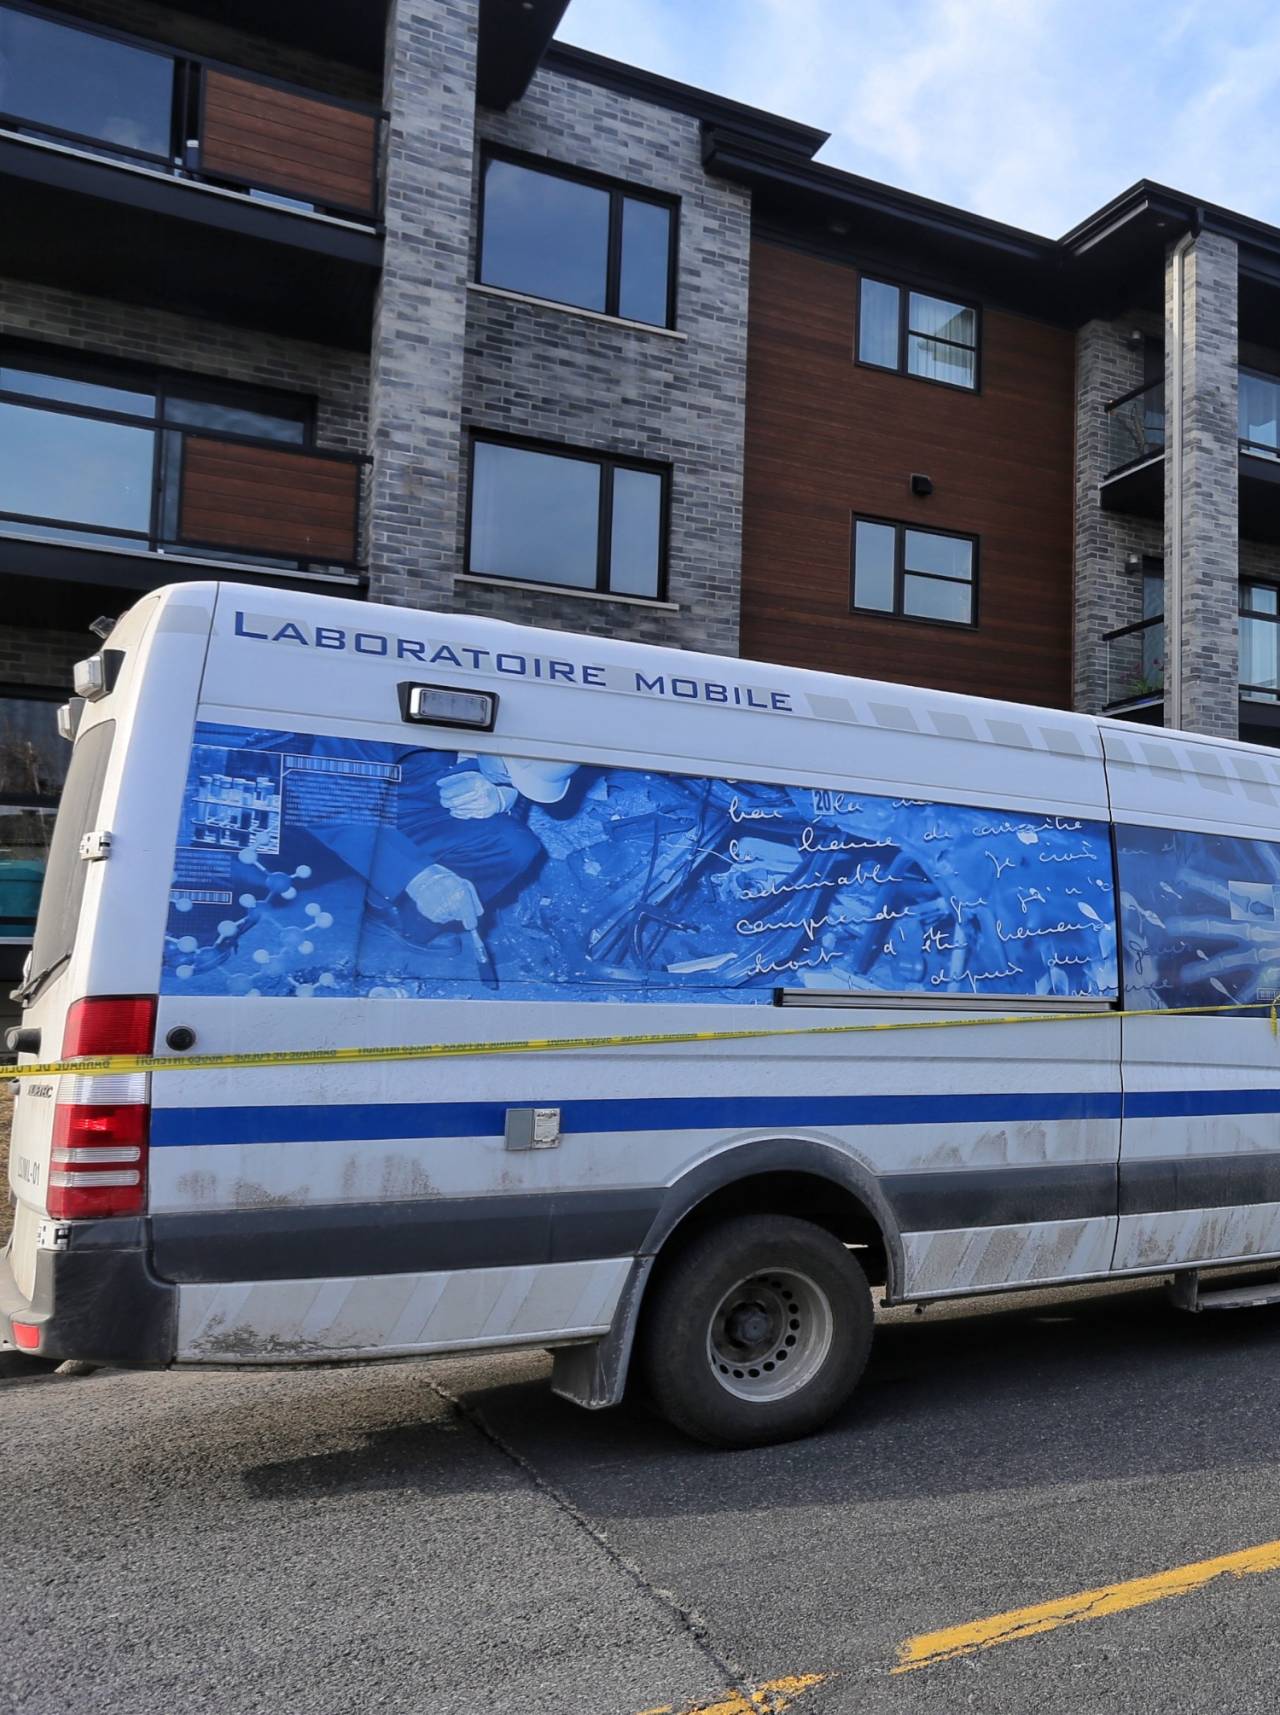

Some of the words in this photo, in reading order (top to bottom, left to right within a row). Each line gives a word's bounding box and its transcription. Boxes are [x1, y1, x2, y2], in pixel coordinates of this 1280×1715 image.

[235, 611, 606, 687] LABORATOIRE
[635, 673, 792, 711] MOBILE
[815, 792, 831, 812] 20
